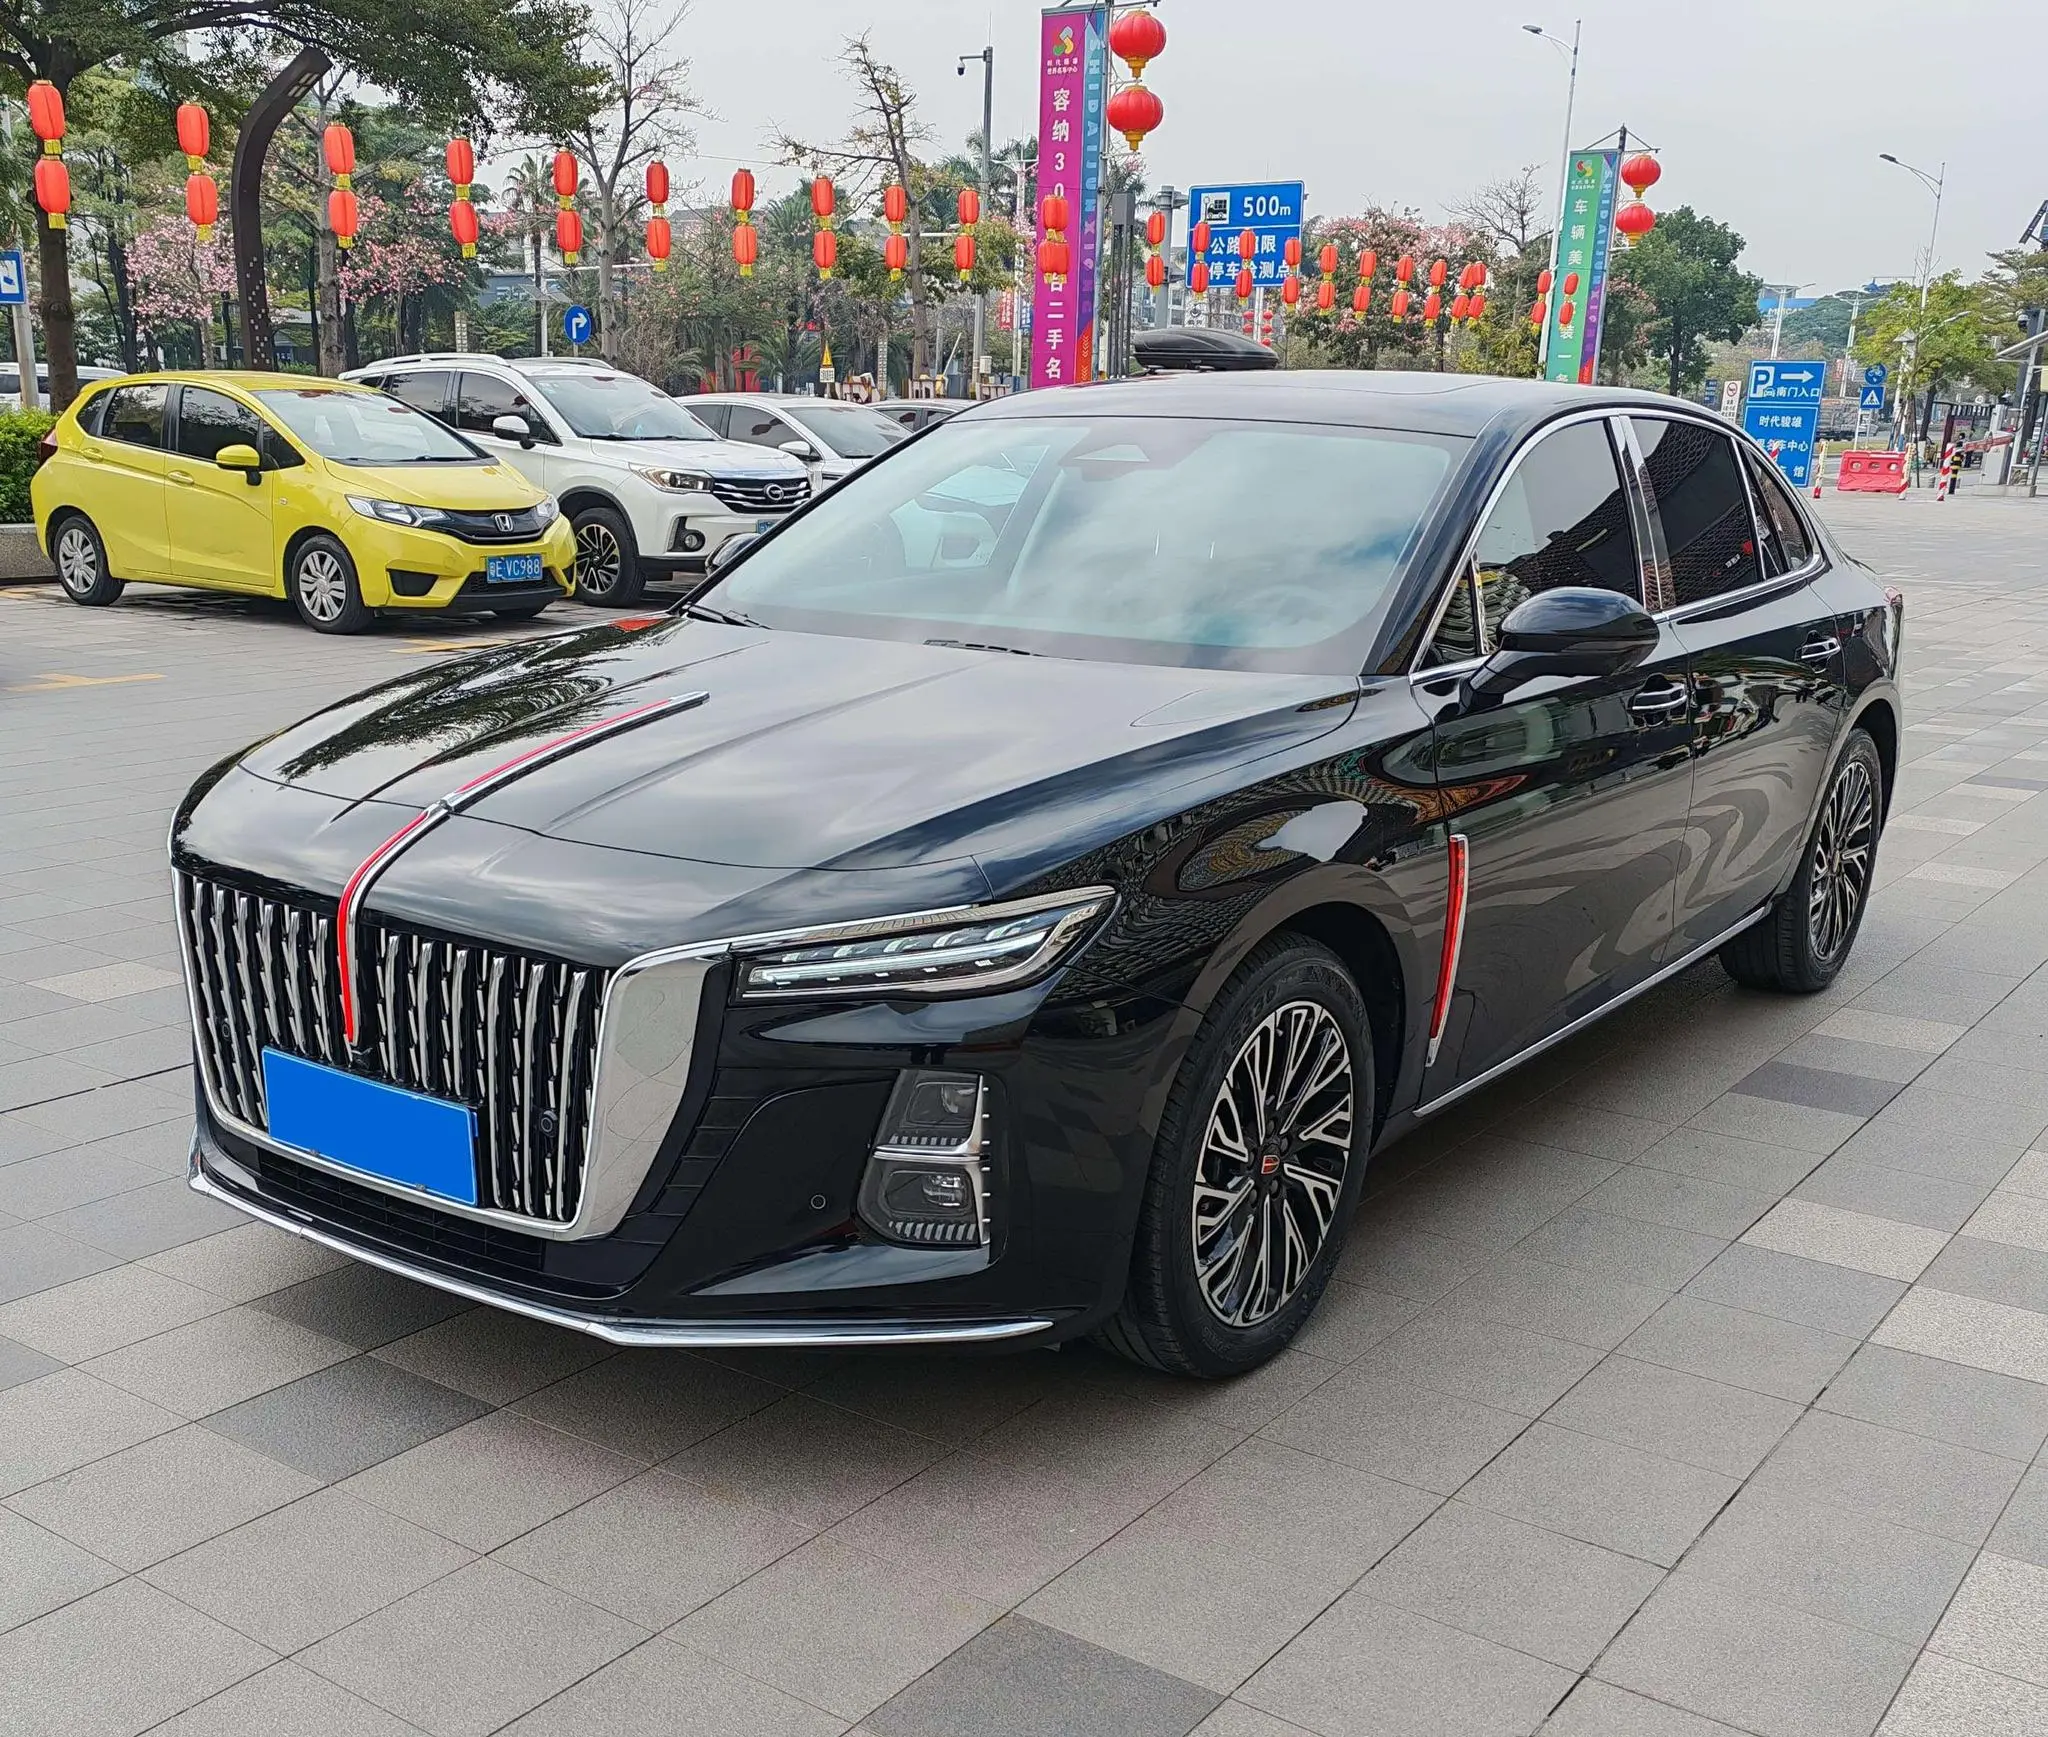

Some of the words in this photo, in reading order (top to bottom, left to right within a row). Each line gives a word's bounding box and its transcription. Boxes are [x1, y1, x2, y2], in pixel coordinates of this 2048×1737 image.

[1243, 196, 1291, 217] 500m
[1045, 87, 1070, 379] 容纳30台二手名
[1775, 387, 1820, 397] 南门入口
